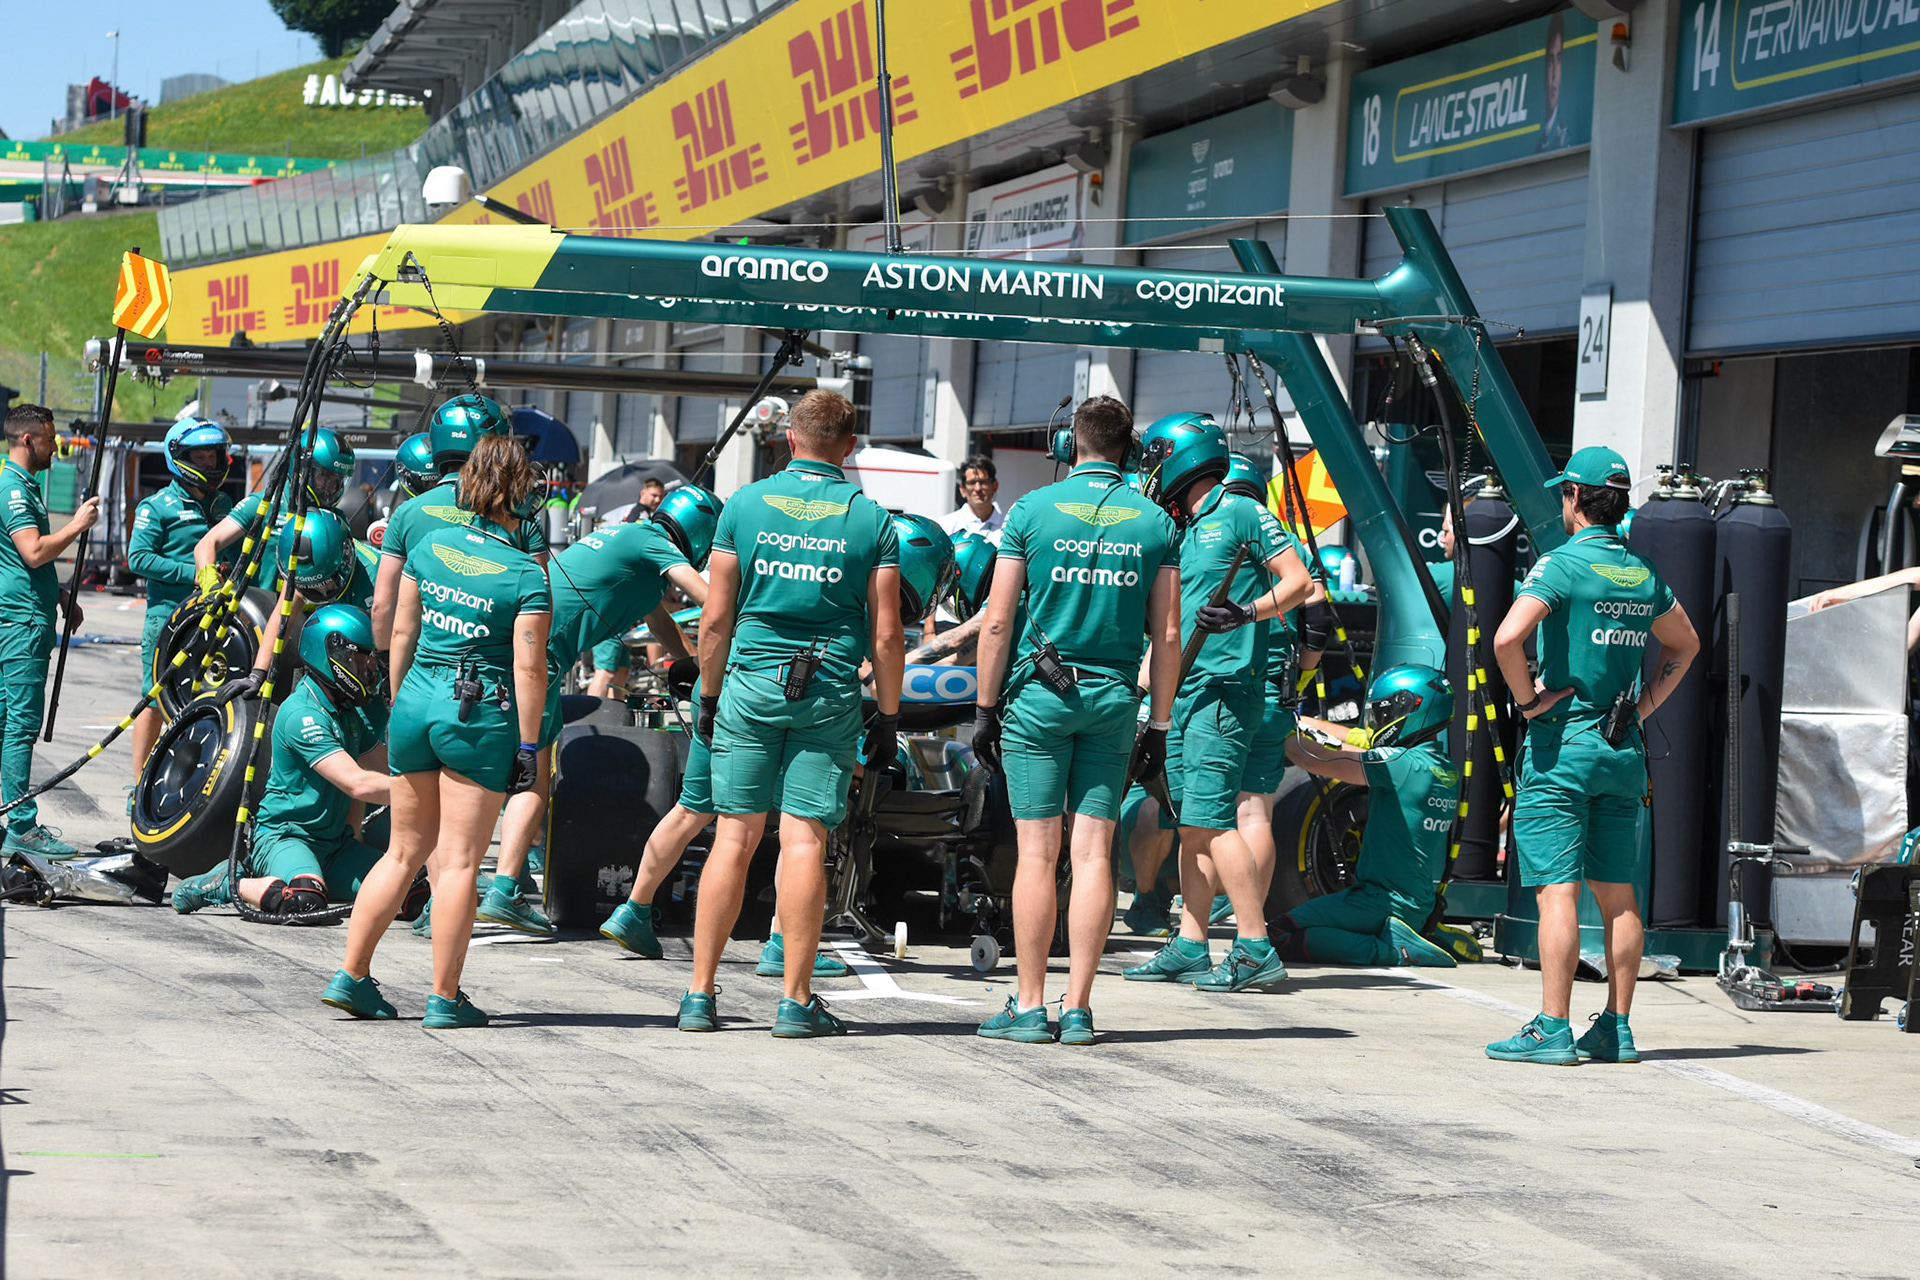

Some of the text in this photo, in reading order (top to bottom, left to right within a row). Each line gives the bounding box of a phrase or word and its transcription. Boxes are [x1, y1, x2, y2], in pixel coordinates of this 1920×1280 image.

[1692, 0, 1722, 91] 14
[1741, 0, 1883, 64] FERNANDO
[788, 0, 896, 160] DHL
[1362, 73, 1528, 166] 18 LANCE STROLL
[671, 79, 754, 209] DHL
[701, 255, 1285, 309] aramco ASTON MARTIN cognizant
[207, 273, 256, 336] DHL
[1581, 314, 1604, 364] 24
[1088, 481, 1109, 489] BOSS
[466, 534, 486, 544] BOSS
[757, 531, 847, 553] cognizant
[1053, 538, 1142, 557] cognizant
[754, 558, 843, 583] aramco
[1051, 566, 1139, 586] aramco
[420, 579, 494, 613] cognizant
[421, 604, 490, 638] aramco
